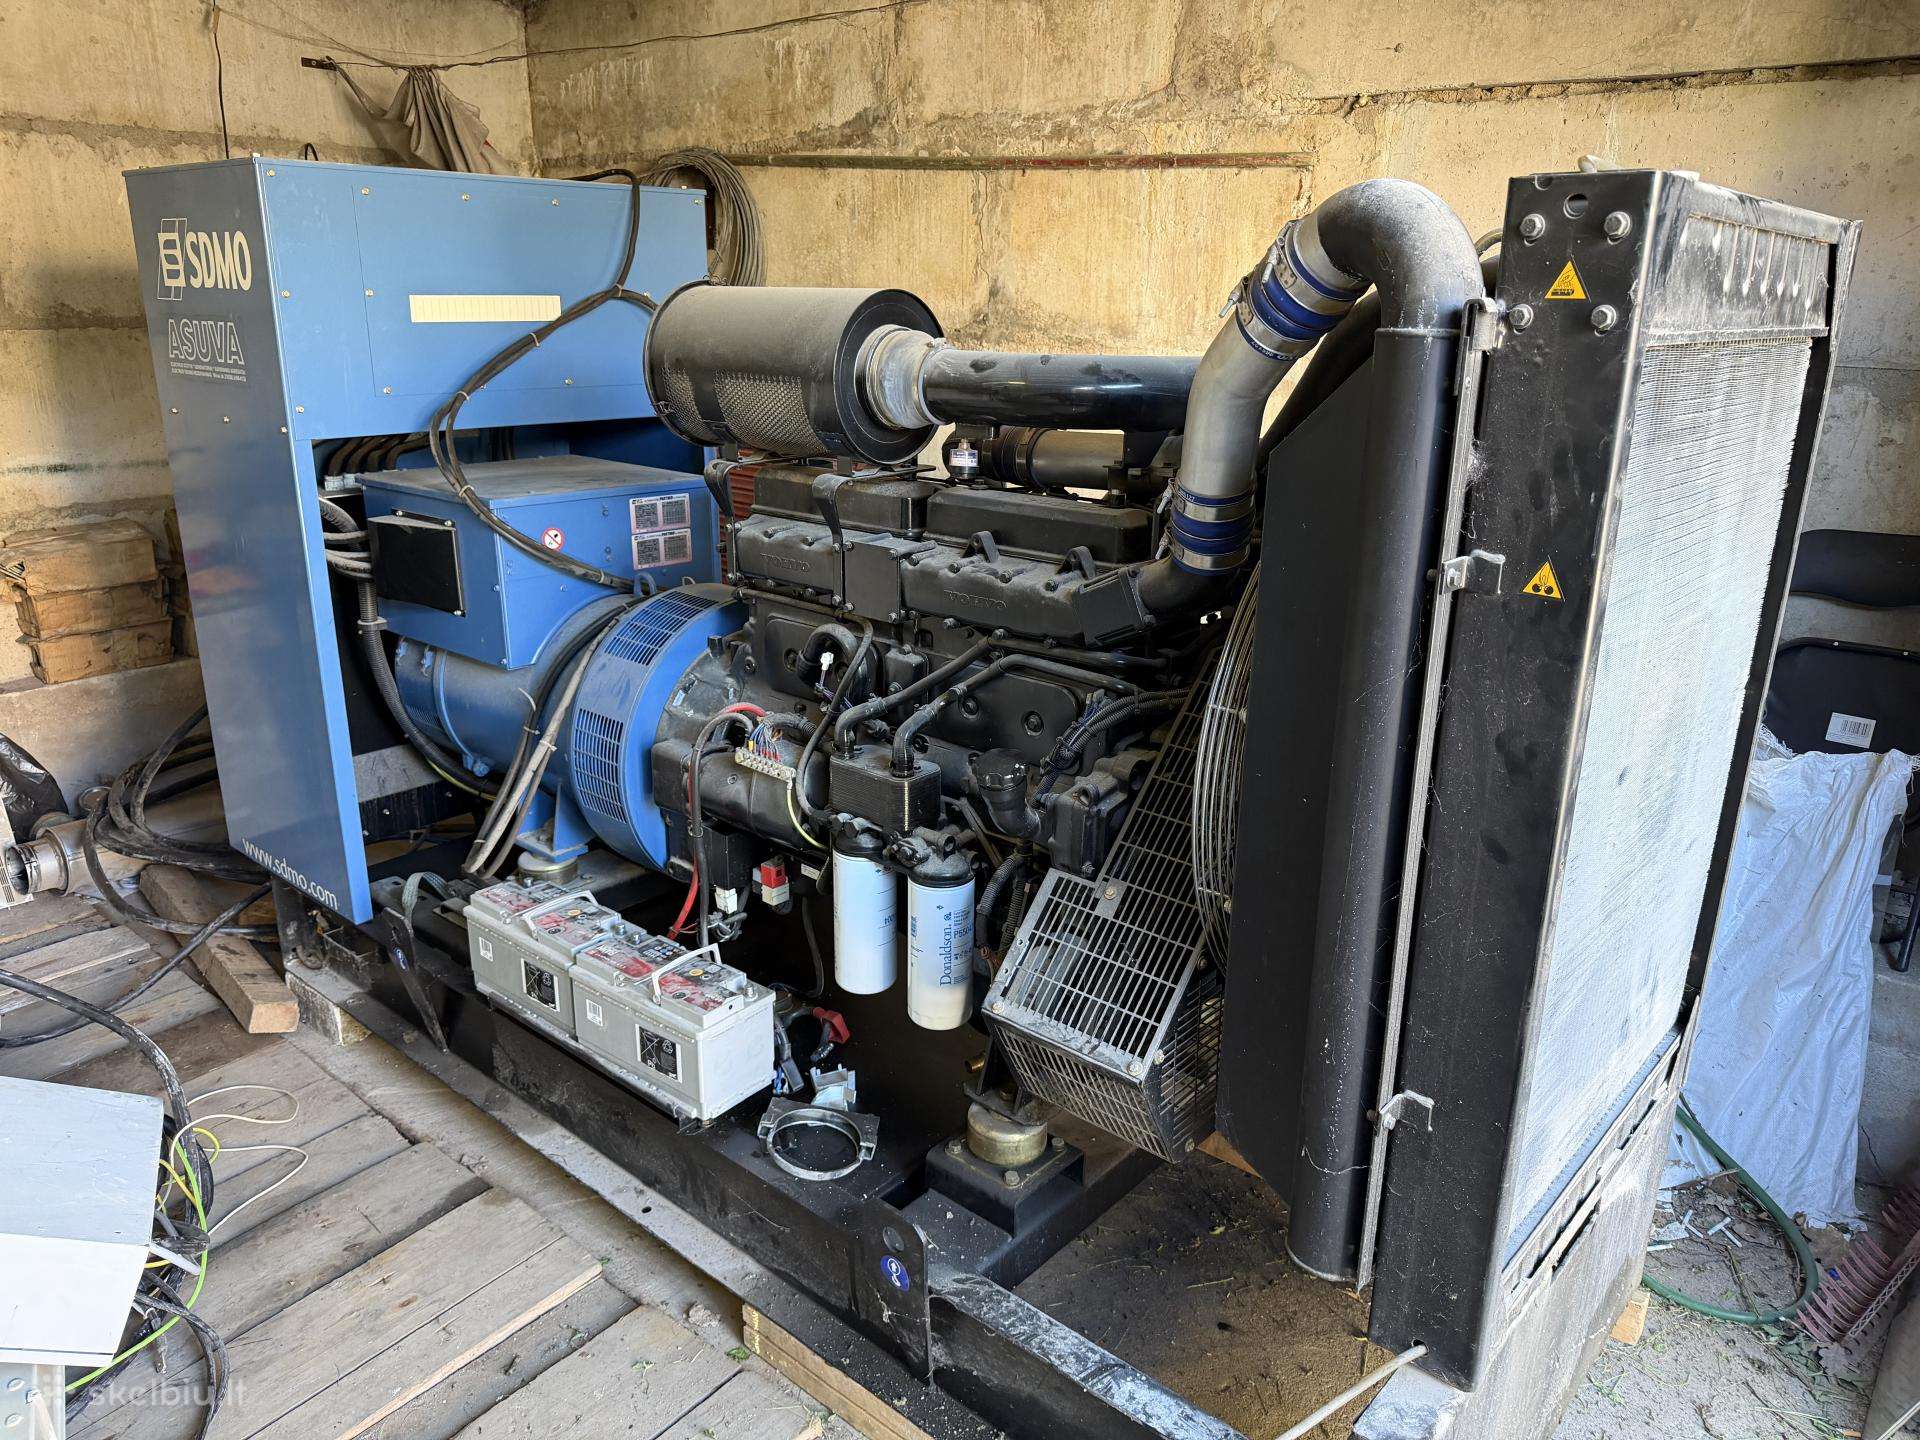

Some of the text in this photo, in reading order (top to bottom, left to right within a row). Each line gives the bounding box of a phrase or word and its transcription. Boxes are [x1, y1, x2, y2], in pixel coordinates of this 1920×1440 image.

[185, 230, 253, 291] SDMO
[168, 318, 245, 365] ASUVA
[242, 836, 339, 911] www.sdmo.com
